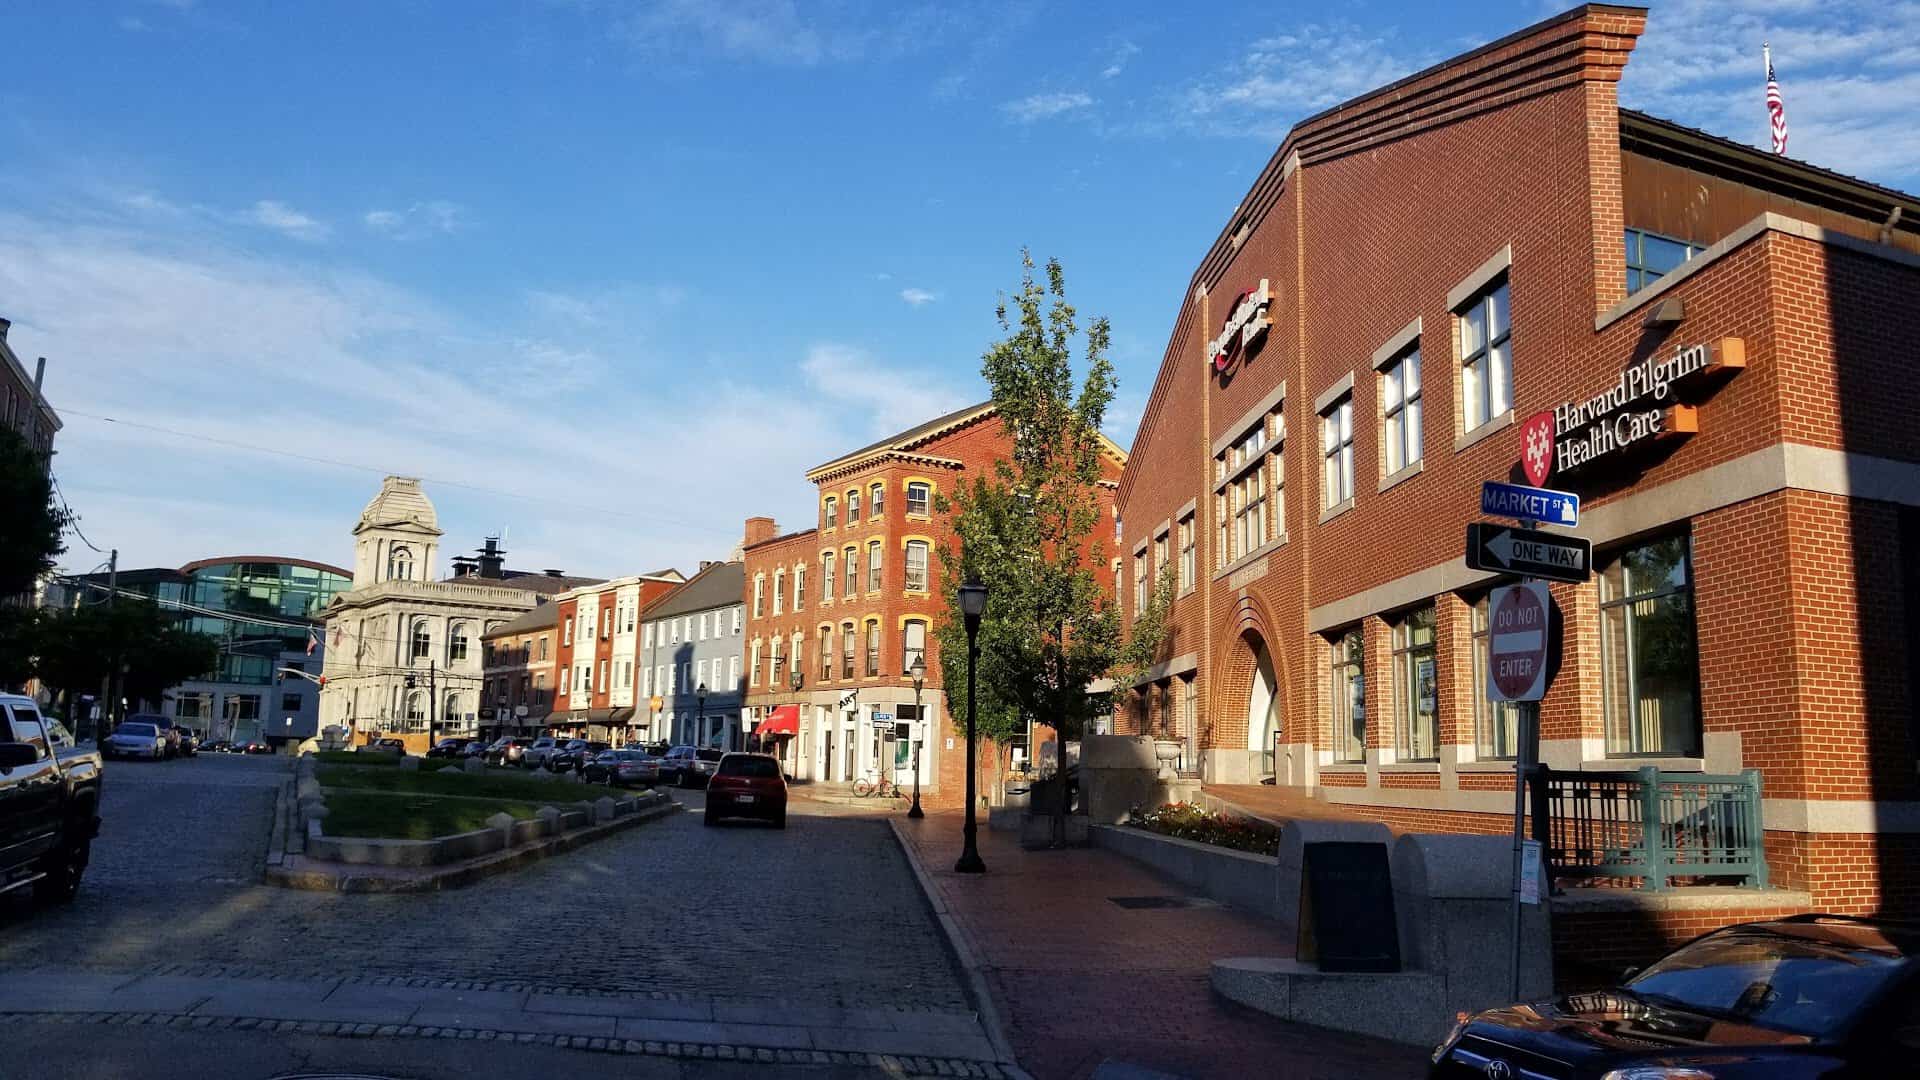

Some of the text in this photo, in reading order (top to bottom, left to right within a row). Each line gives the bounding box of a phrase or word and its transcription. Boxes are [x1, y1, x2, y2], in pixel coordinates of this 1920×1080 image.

[1554, 344, 1707, 436] Harvard Pilgrim
[1556, 408, 1661, 473] Health Care
[1483, 488, 1561, 516] MARKET ST
[1512, 541, 1579, 569] ONE WAY
[1499, 606, 1538, 627] DO NOT
[1500, 657, 1532, 678] ENTER
[839, 692, 857, 710] ART
